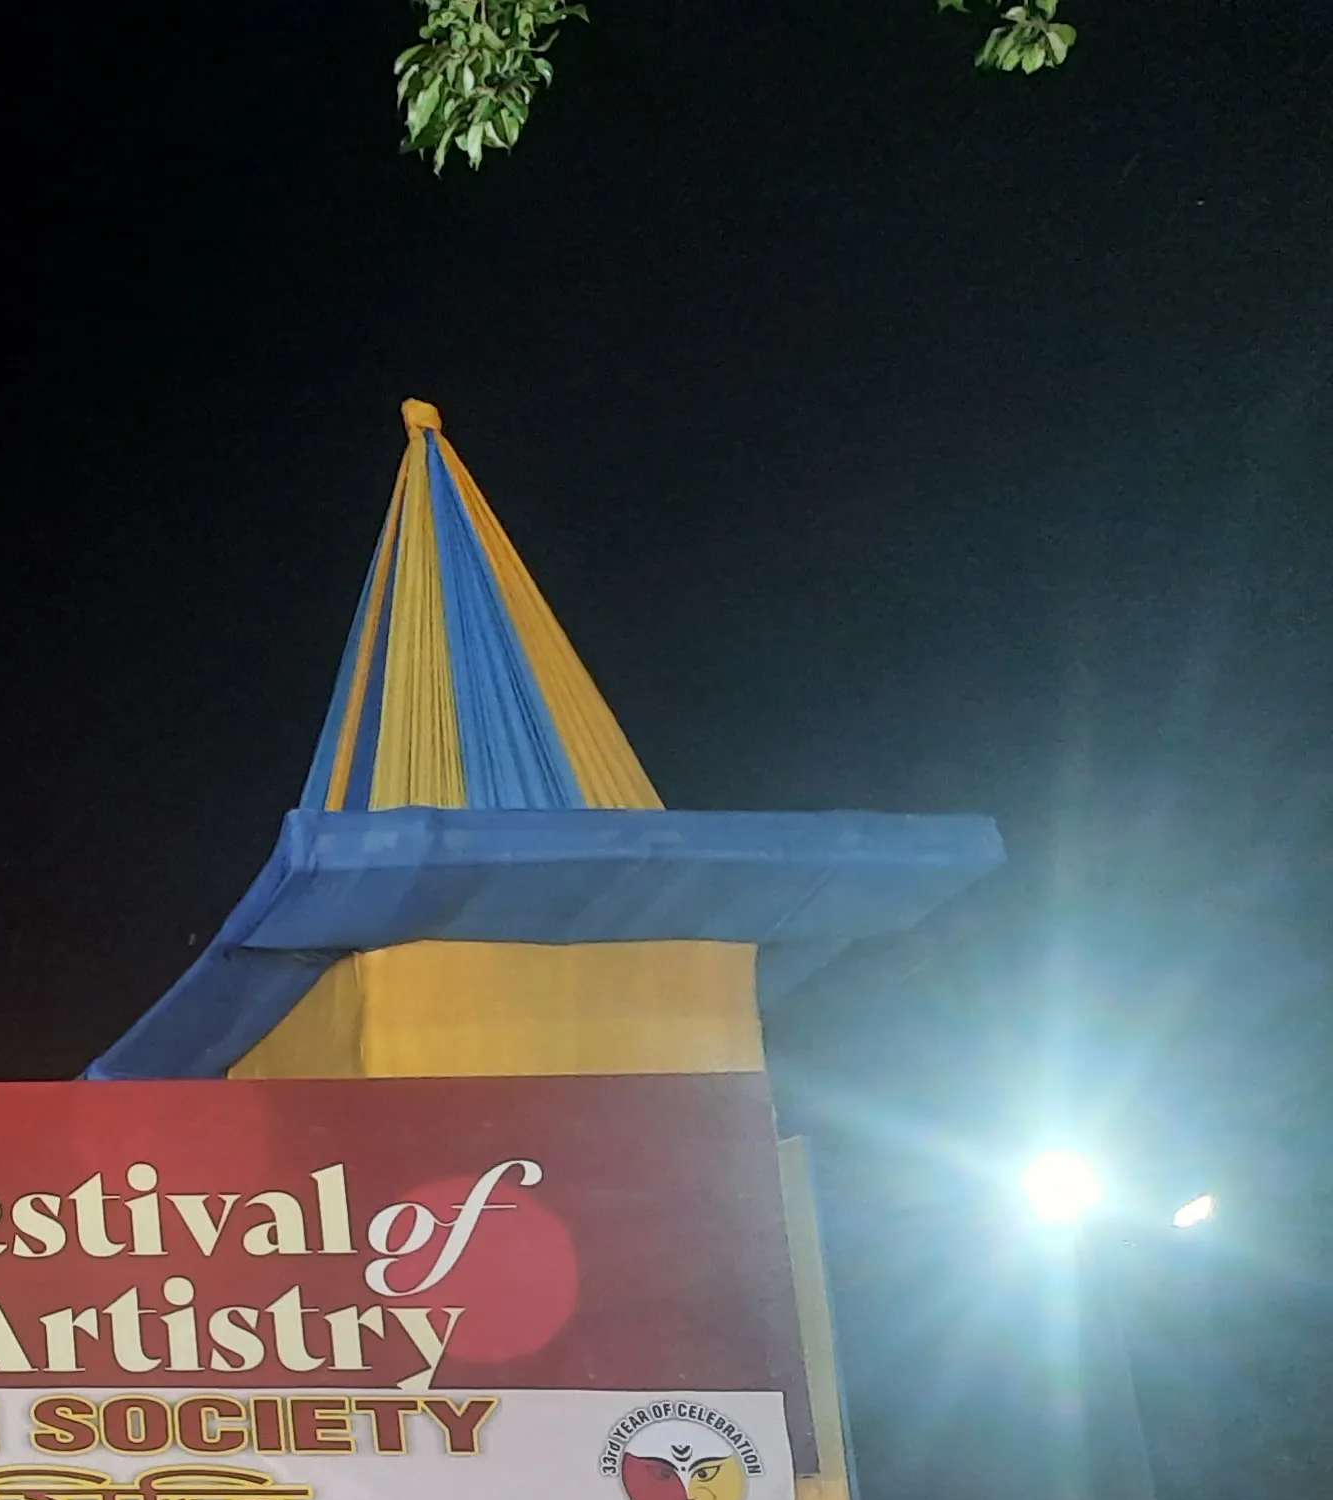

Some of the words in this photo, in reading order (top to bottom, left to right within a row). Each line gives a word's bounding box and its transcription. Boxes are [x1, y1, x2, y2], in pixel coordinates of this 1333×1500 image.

[363, 1159, 543, 1297] of
[29, 1393, 503, 1456] SOCIETY
[602, 1440, 621, 1474] 33rd
[612, 1410, 650, 1440] YEAR
[651, 1403, 673, 1419] OF
[677, 1403, 762, 1475] CELEBRATION
